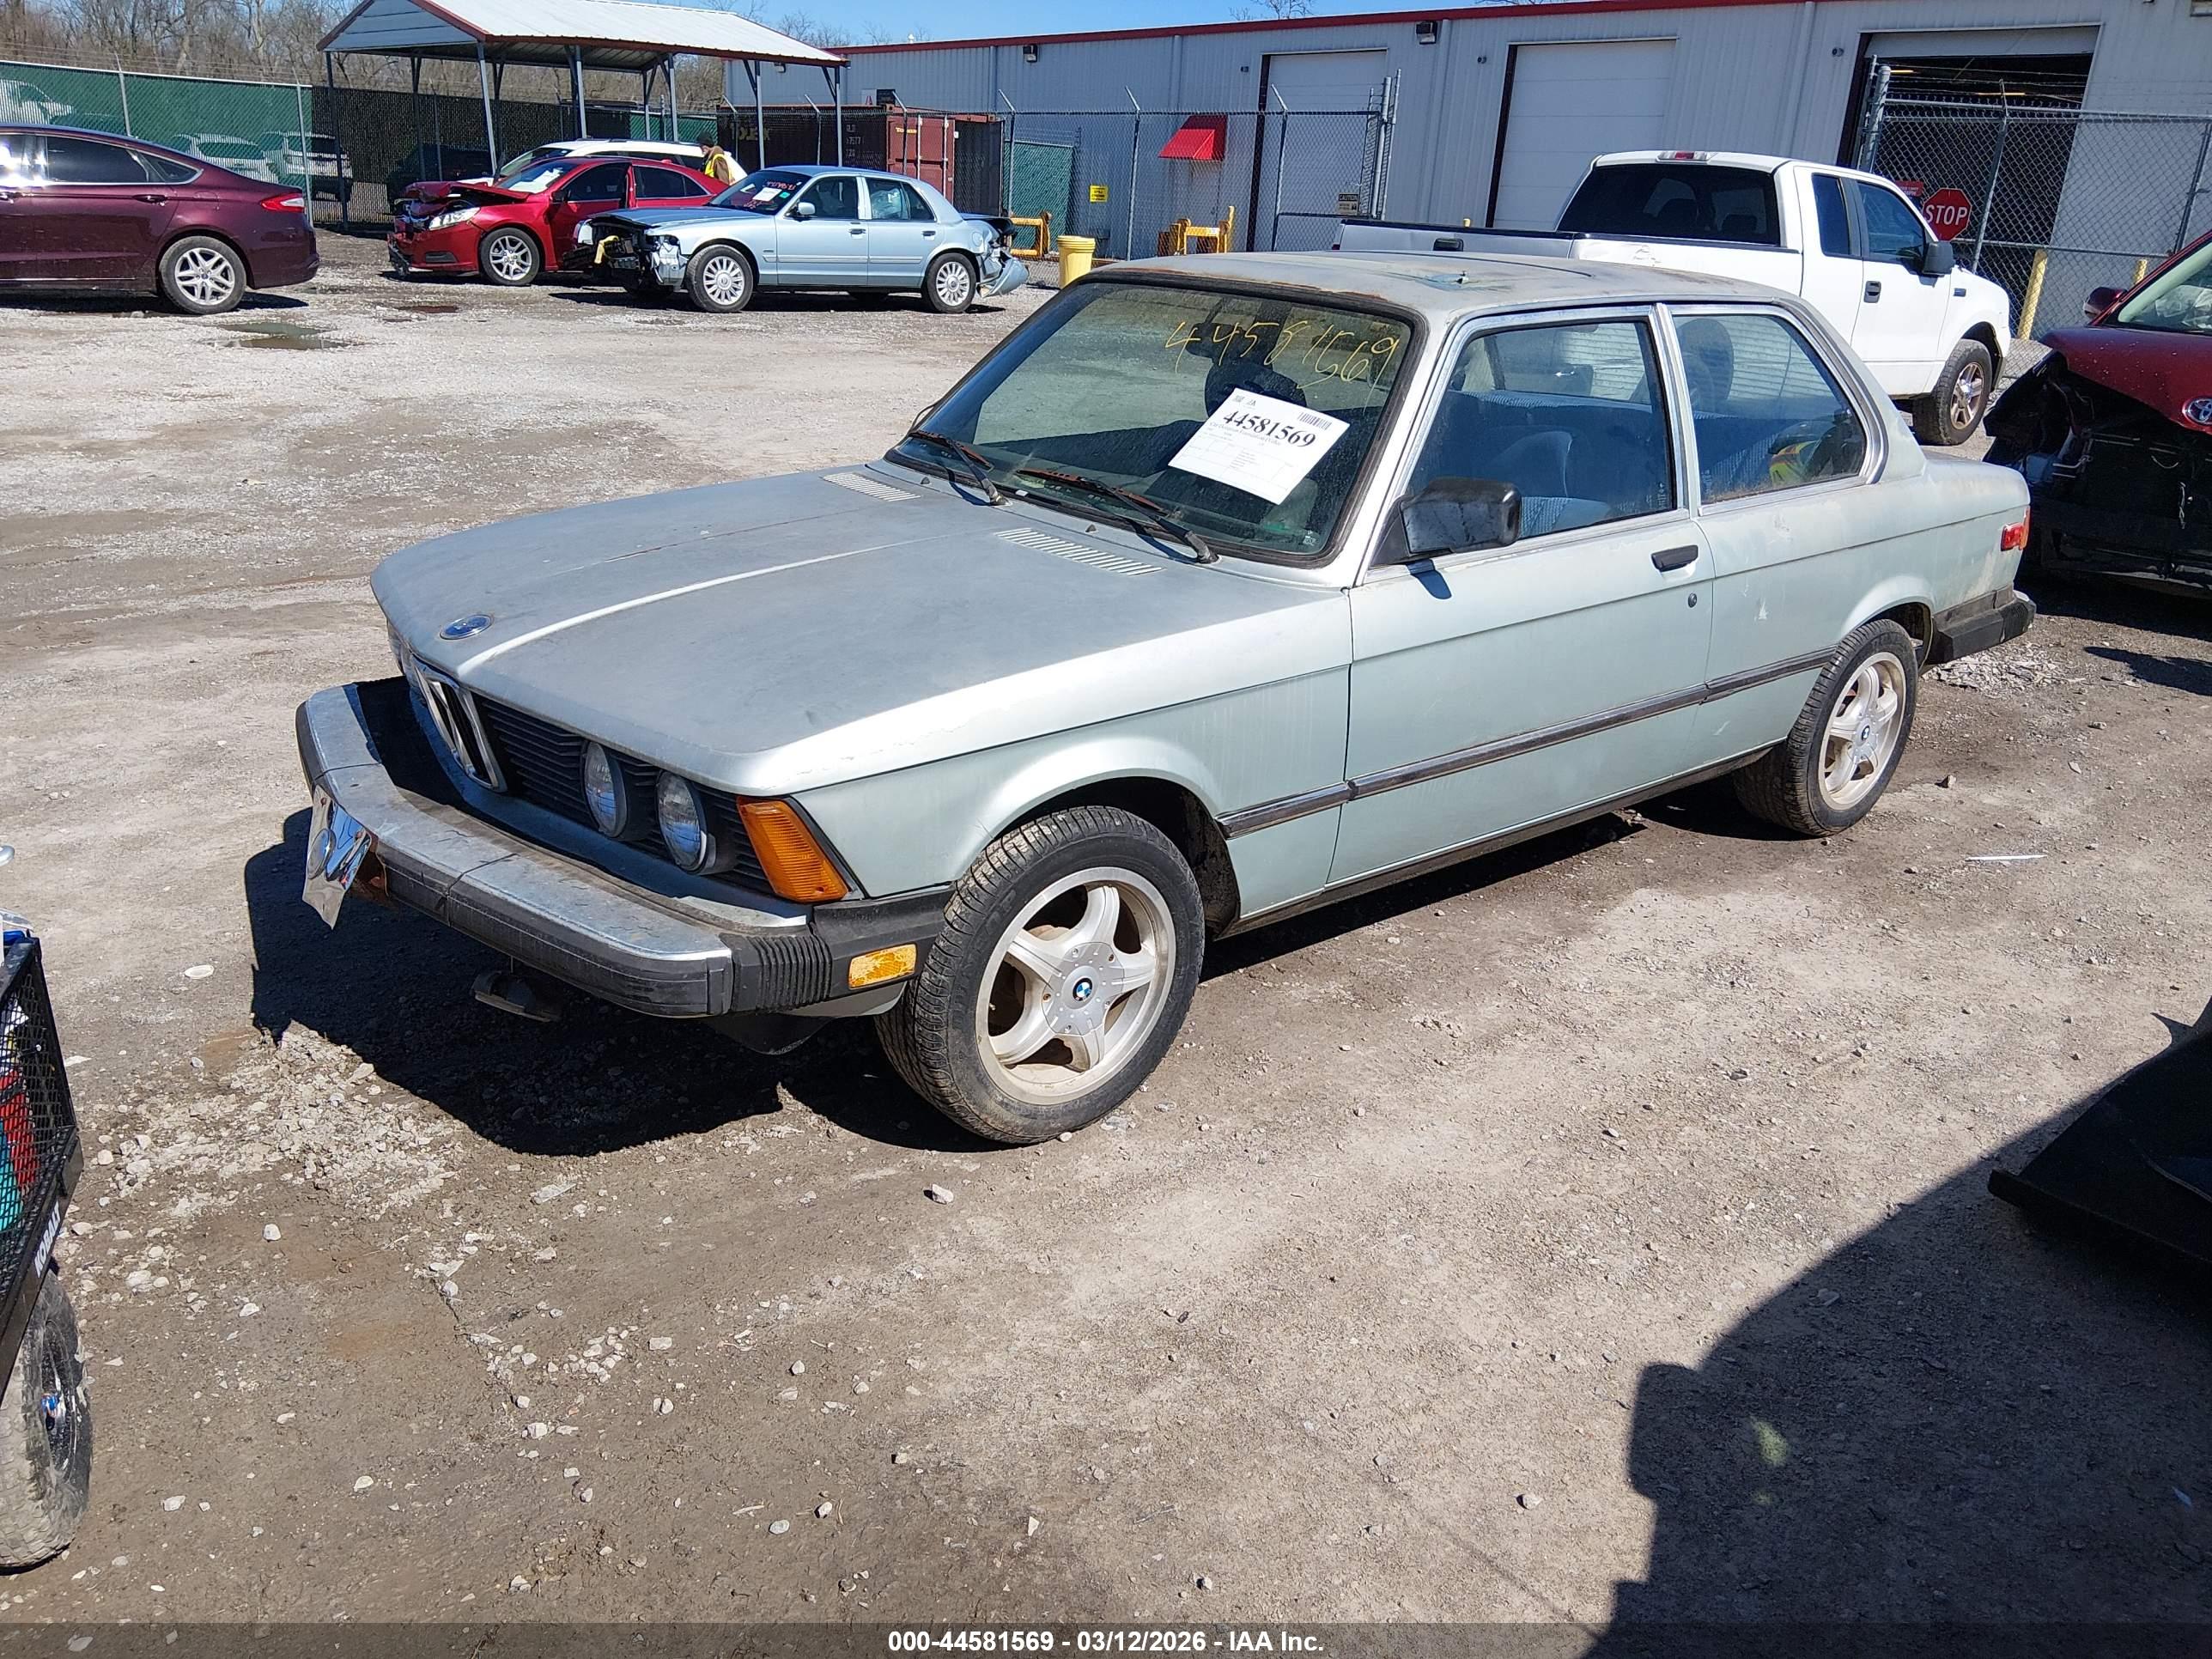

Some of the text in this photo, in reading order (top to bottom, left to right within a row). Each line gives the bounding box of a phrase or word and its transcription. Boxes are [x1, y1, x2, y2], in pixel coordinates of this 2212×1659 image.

[1925, 204, 1968, 226] STOP
[1164, 320, 1401, 416] 44581569
[1223, 410, 1316, 447] 44581569
[33, 1200, 61, 1279] KOBALT
